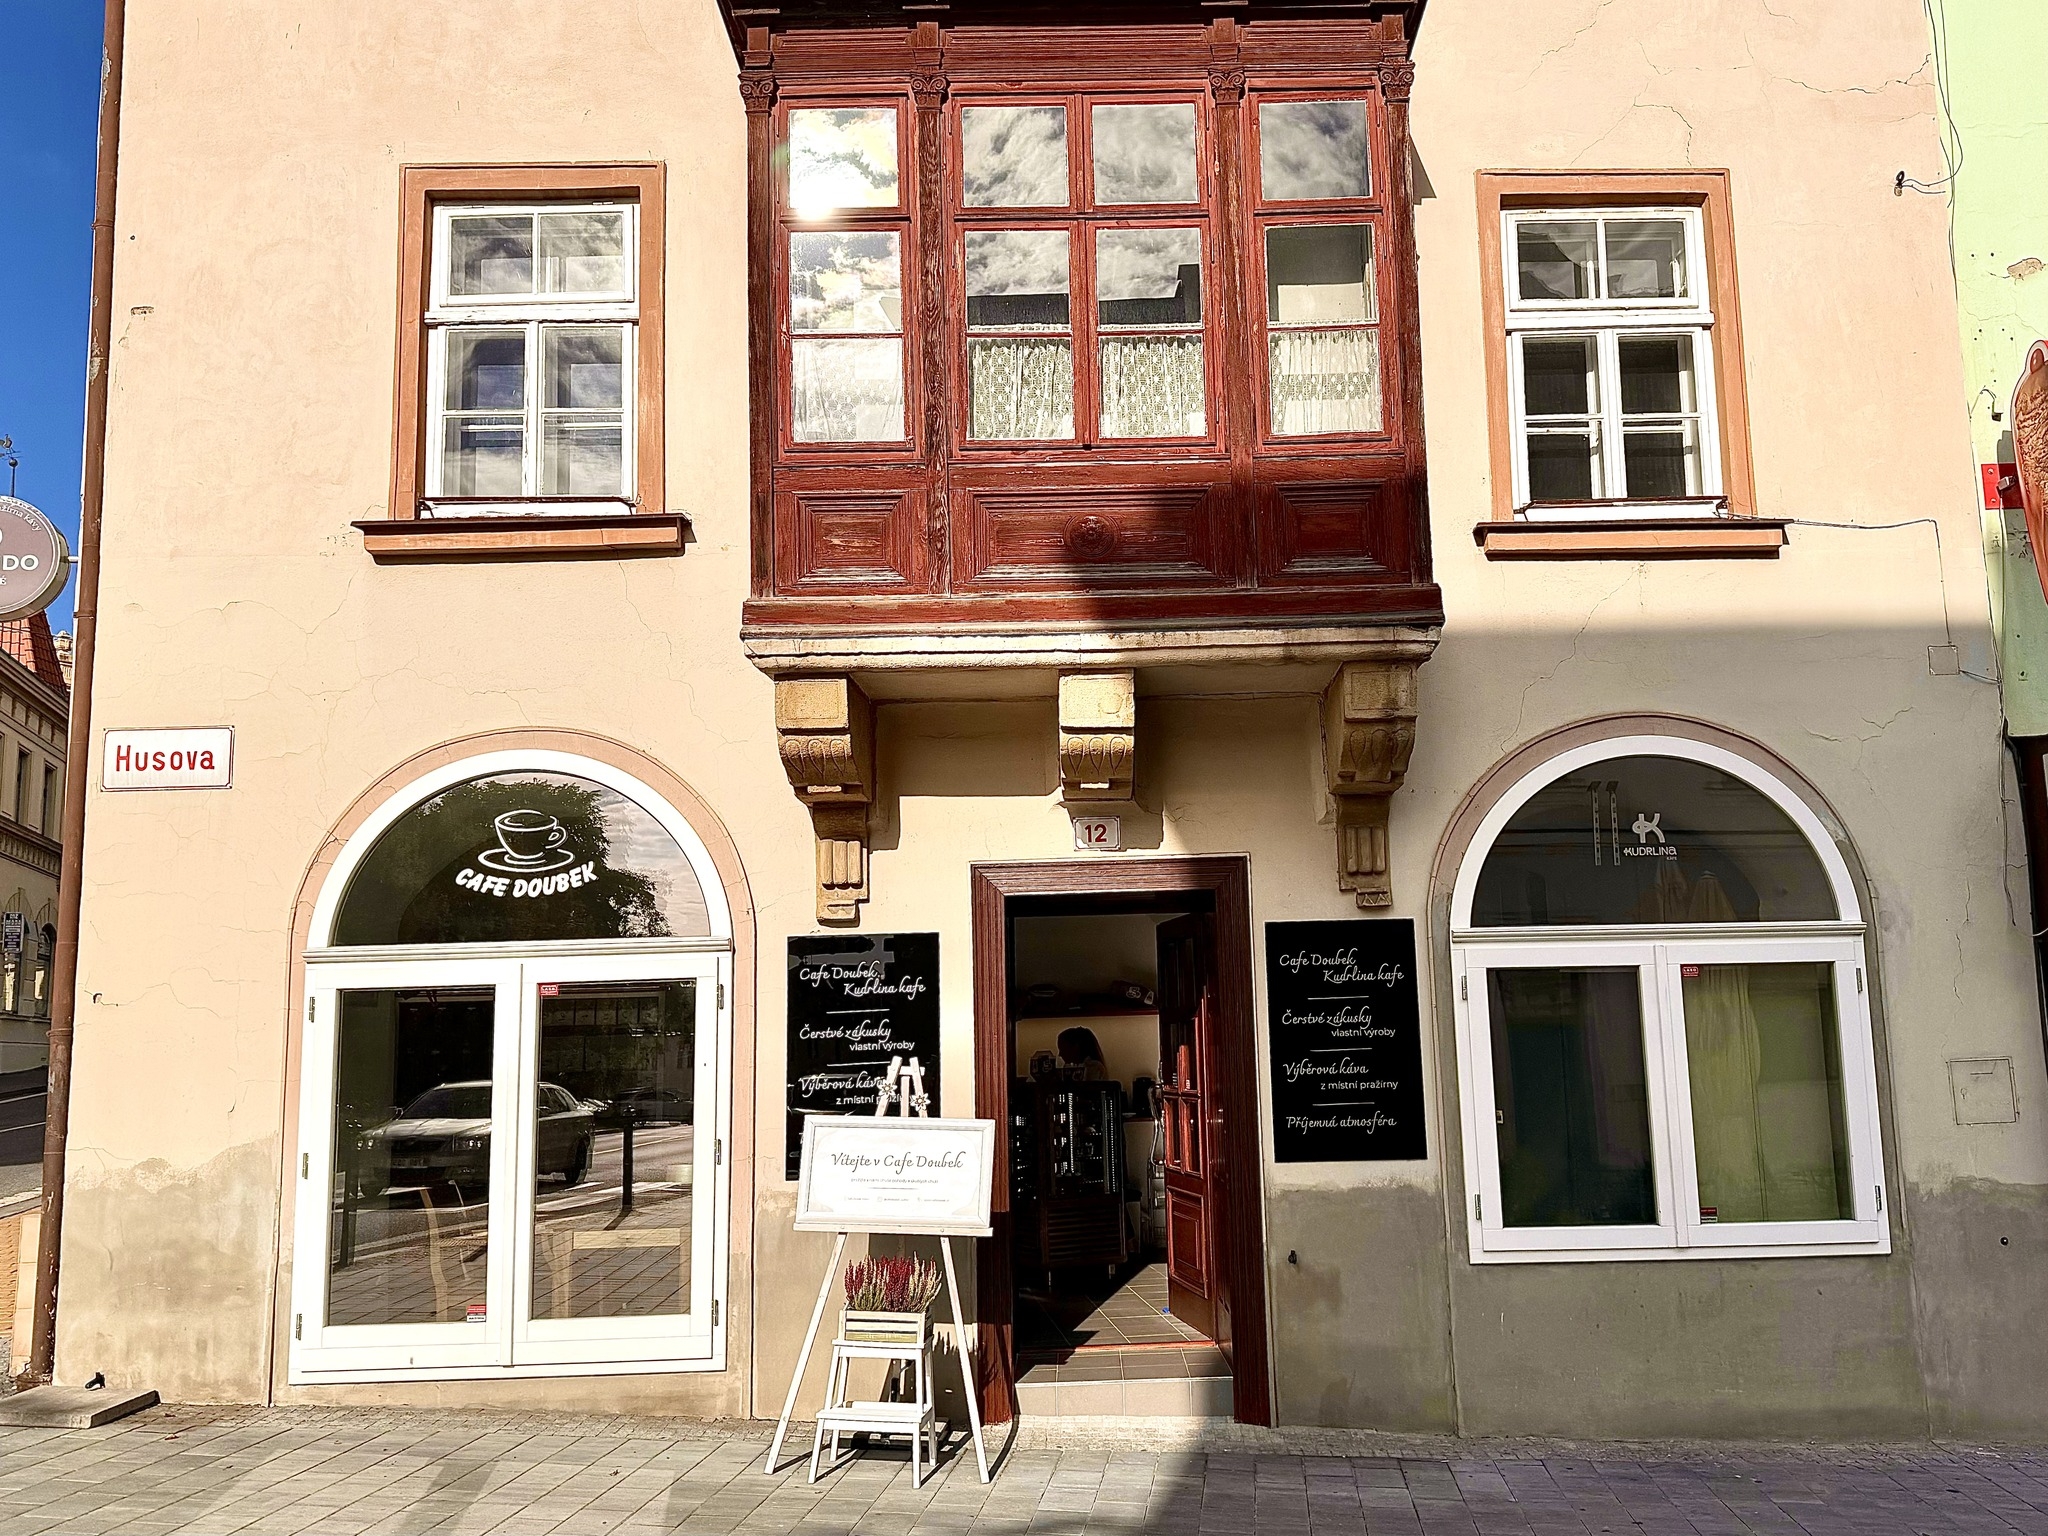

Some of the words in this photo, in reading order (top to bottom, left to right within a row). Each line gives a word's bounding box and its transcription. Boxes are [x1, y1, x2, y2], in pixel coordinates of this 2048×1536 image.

[0, 505, 24, 518] žírna
[24, 513, 42, 531] kávy
[115, 745, 215, 772] Husova
[1084, 823, 1108, 843] 12
[455, 868, 511, 897] CAFE
[512, 861, 598, 898] DOUBEK
[1279, 950, 1310, 974] Cafe
[1310, 947, 1358, 966] Doubek
[799, 963, 831, 988] Cafe
[831, 960, 881, 979] Doubek
[1323, 964, 1377, 984] Kudrlina
[1377, 962, 1405, 988] kafe
[843, 977, 898, 998] Kudrlina
[898, 975, 927, 1000] kafe
[1282, 1008, 1325, 1025] Čerstvé
[1326, 1005, 1372, 1030] zákusky
[799, 1023, 844, 1040] Čerstvé
[844, 1018, 892, 1043] zákusky
[1331, 1028, 1362, 1037] vlastní
[1363, 1027, 1396, 1038] výroby
[849, 1041, 881, 1051] vlastní
[882, 1040, 915, 1052] výroby
[1282, 1058, 1338, 1083] Výběrová
[1339, 1056, 1369, 1074] káva
[798, 1072, 854, 1098] Výběrová
[1320, 1082, 1326, 1090] z
[1327, 1080, 1358, 1090] místní
[1359, 1080, 1399, 1091] pražírny
[836, 1096, 842, 1105] z
[843, 1095, 875, 1105] místní
[1285, 1115, 1338, 1135] Příjemná
[1339, 1110, 1398, 1135] atmosféra
[831, 1152, 872, 1173] Vítejte
[873, 1157, 881, 1166] v
[883, 1151, 915, 1175] Cafe
[915, 1151, 967, 1168] Doubek
